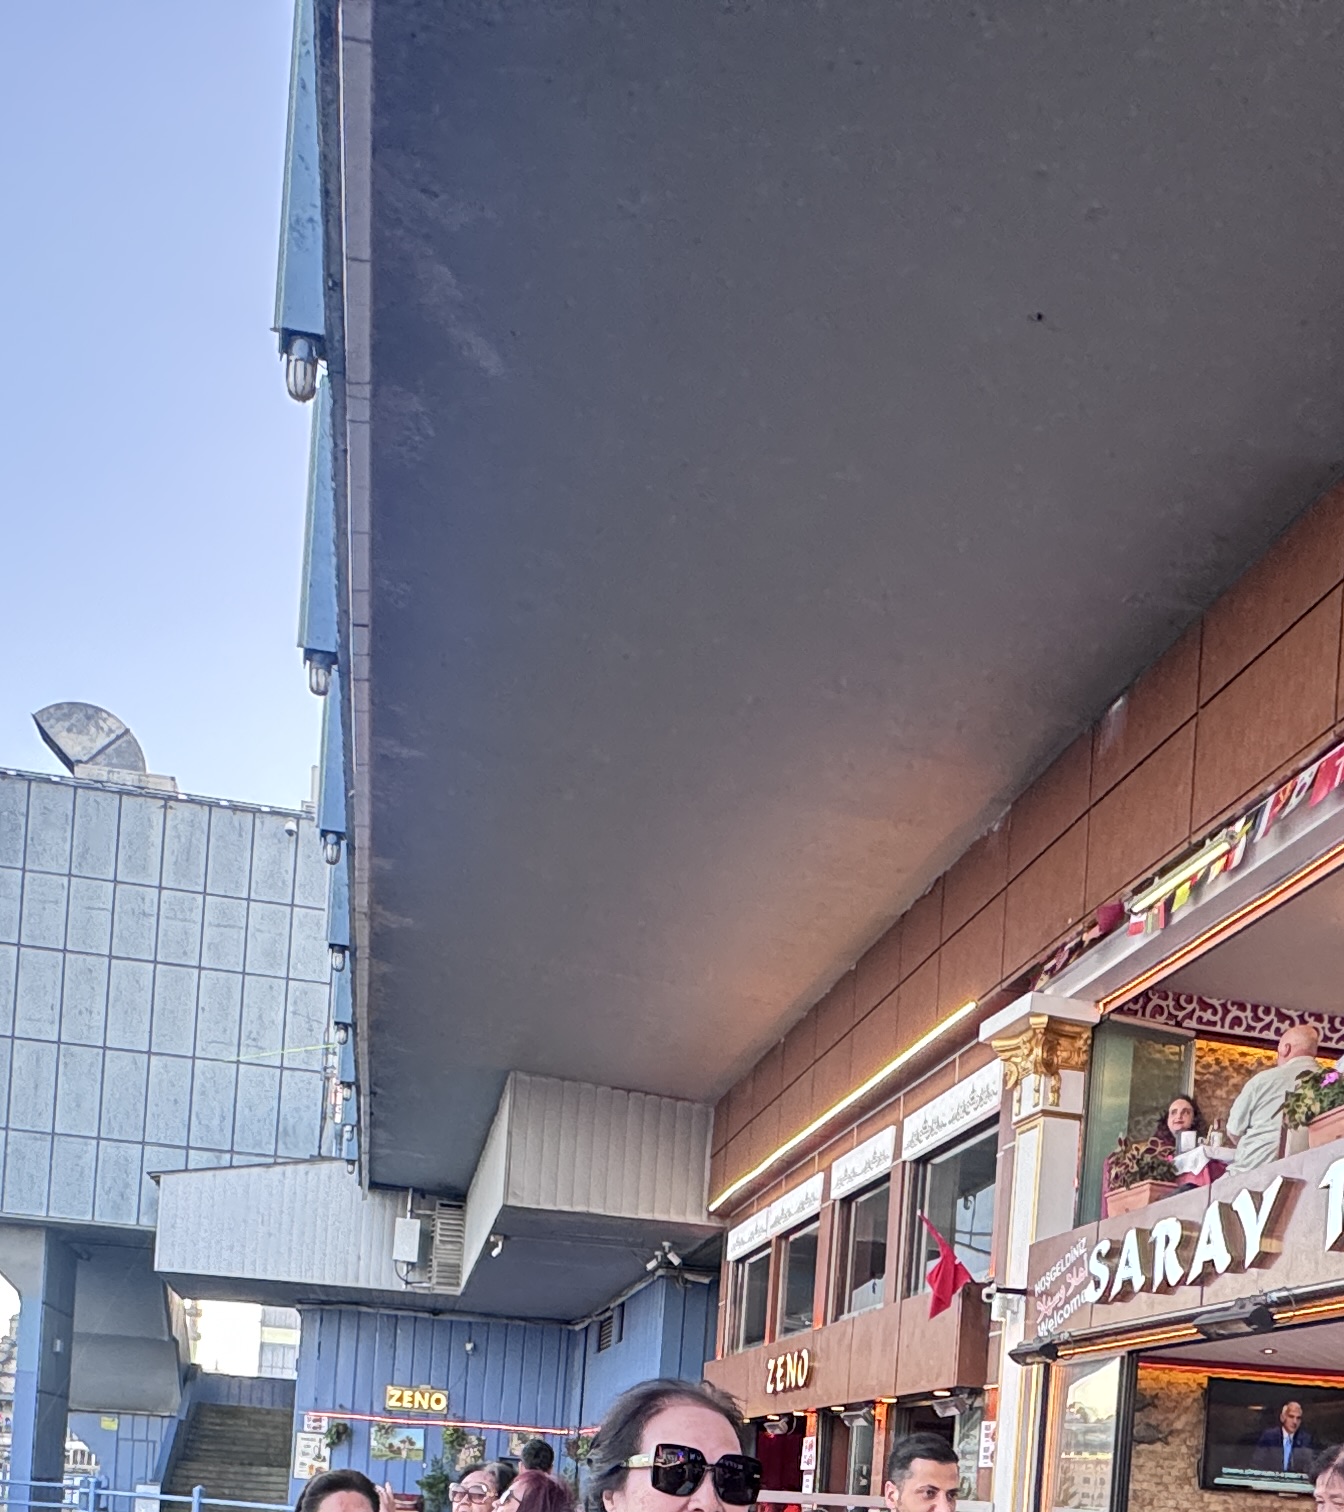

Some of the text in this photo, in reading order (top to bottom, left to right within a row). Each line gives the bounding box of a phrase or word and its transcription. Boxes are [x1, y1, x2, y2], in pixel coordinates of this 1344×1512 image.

[1084, 1175, 1285, 1304] SARAY
[766, 1348, 809, 1394] ZENO
[388, 1389, 447, 1411] ZENO
